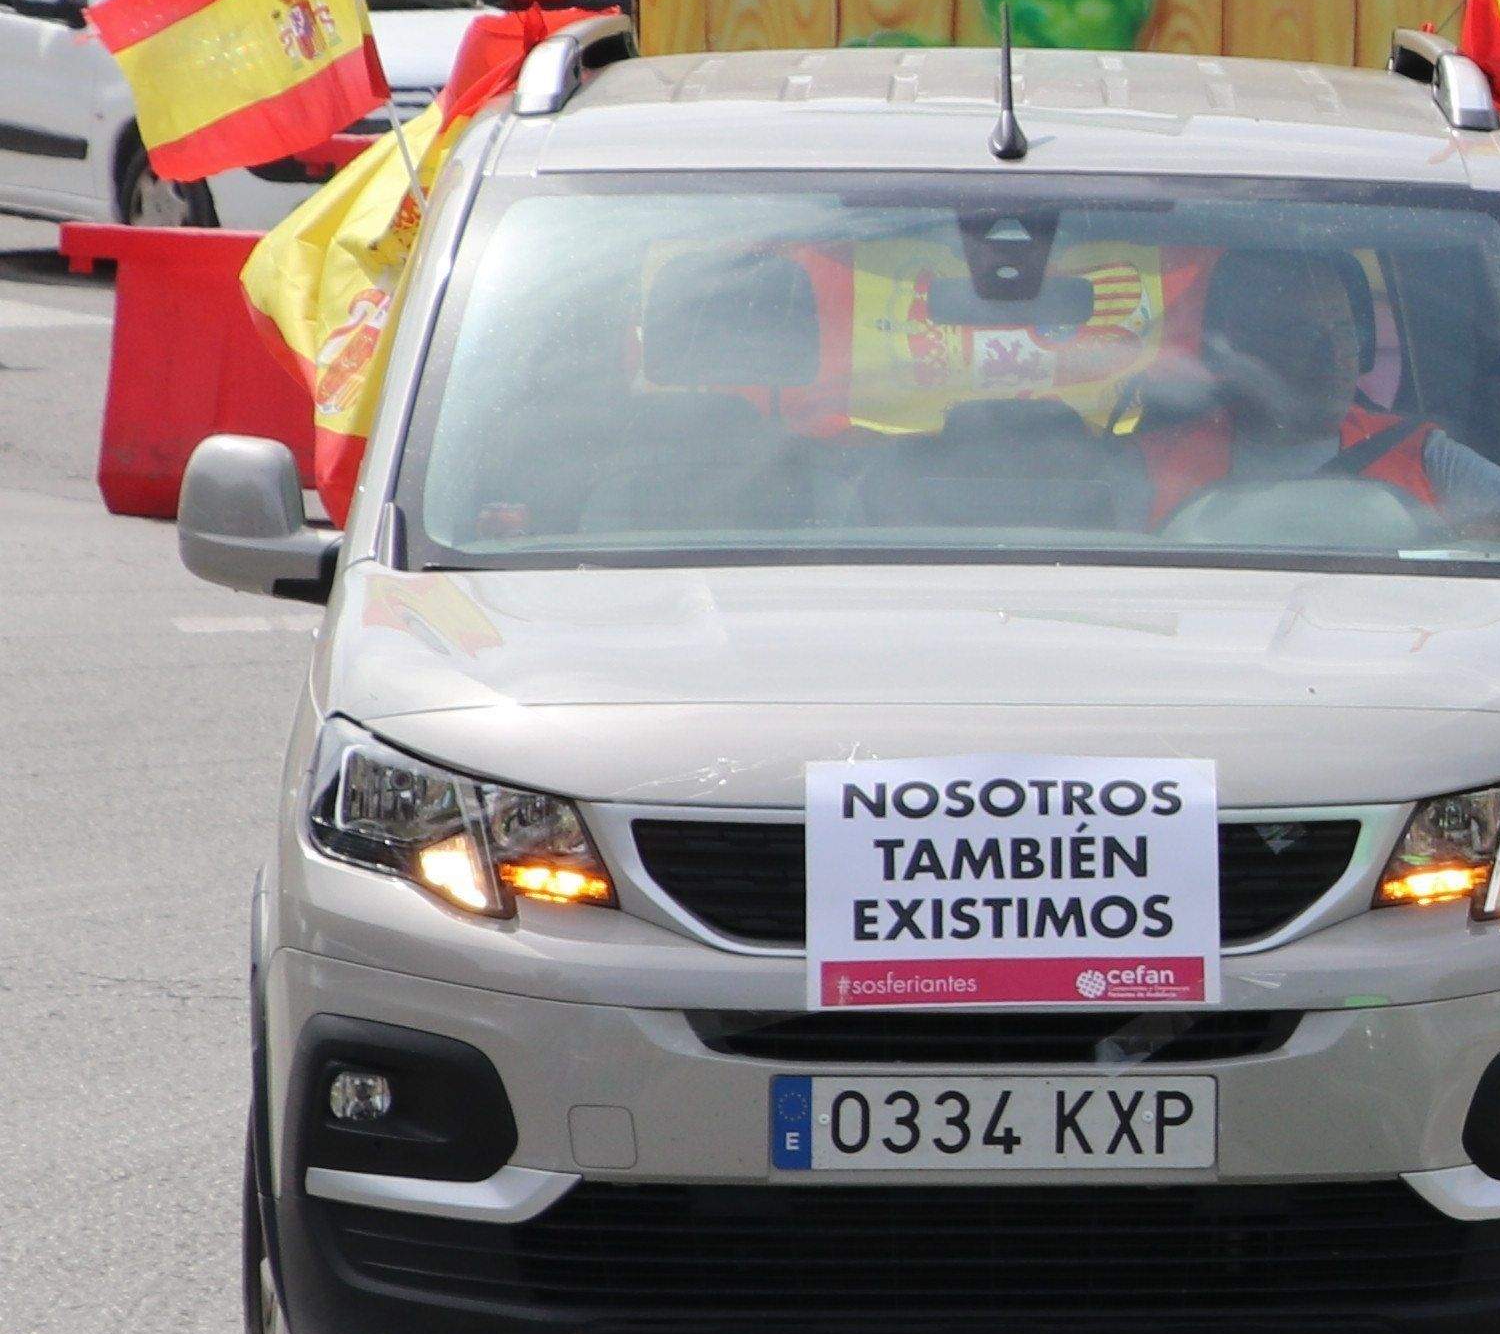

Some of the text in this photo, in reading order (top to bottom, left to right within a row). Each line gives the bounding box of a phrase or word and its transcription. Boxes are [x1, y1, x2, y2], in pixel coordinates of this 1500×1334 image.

[842, 778, 1183, 819] NOSOTROS
[873, 821, 1149, 881] TAMBIÉN
[852, 895, 1173, 941] EXISTIMOS
[836, 964, 1175, 999] #sosferiantes cefan
[785, 1089, 1194, 1156] E 0334 KXP
